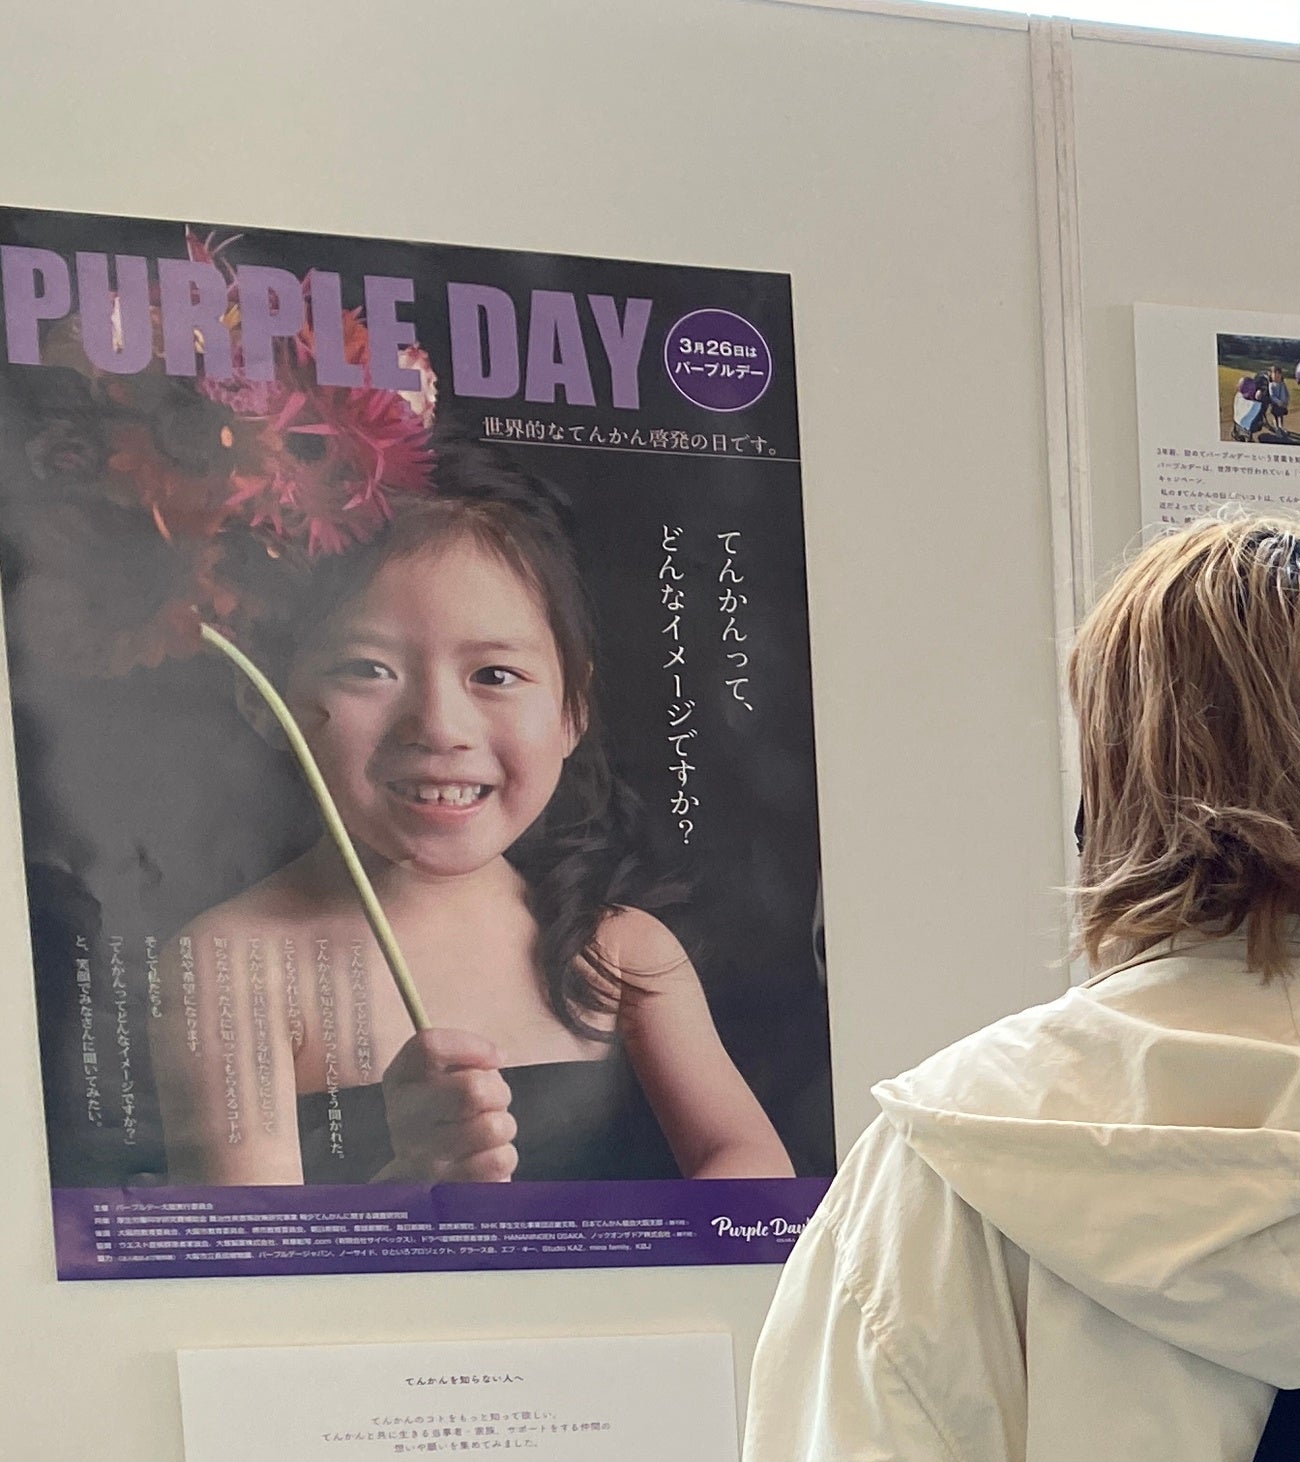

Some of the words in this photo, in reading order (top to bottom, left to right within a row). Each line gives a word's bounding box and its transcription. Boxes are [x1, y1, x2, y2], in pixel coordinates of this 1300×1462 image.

[0, 245, 422, 391] PURPLE
[446, 281, 654, 410] DAY
[679, 337, 758, 359] 3月26日は
[675, 361, 764, 380] パープルデー
[484, 415, 777, 456] 世界的なてんかん啓発の日です。
[717, 531, 753, 711] てんかんって、
[659, 524, 700, 845] どんなイメージですか？
[711, 1216, 769, 1241] Purple
[405, 1373, 525, 1387] てんかんを知らない人へ
